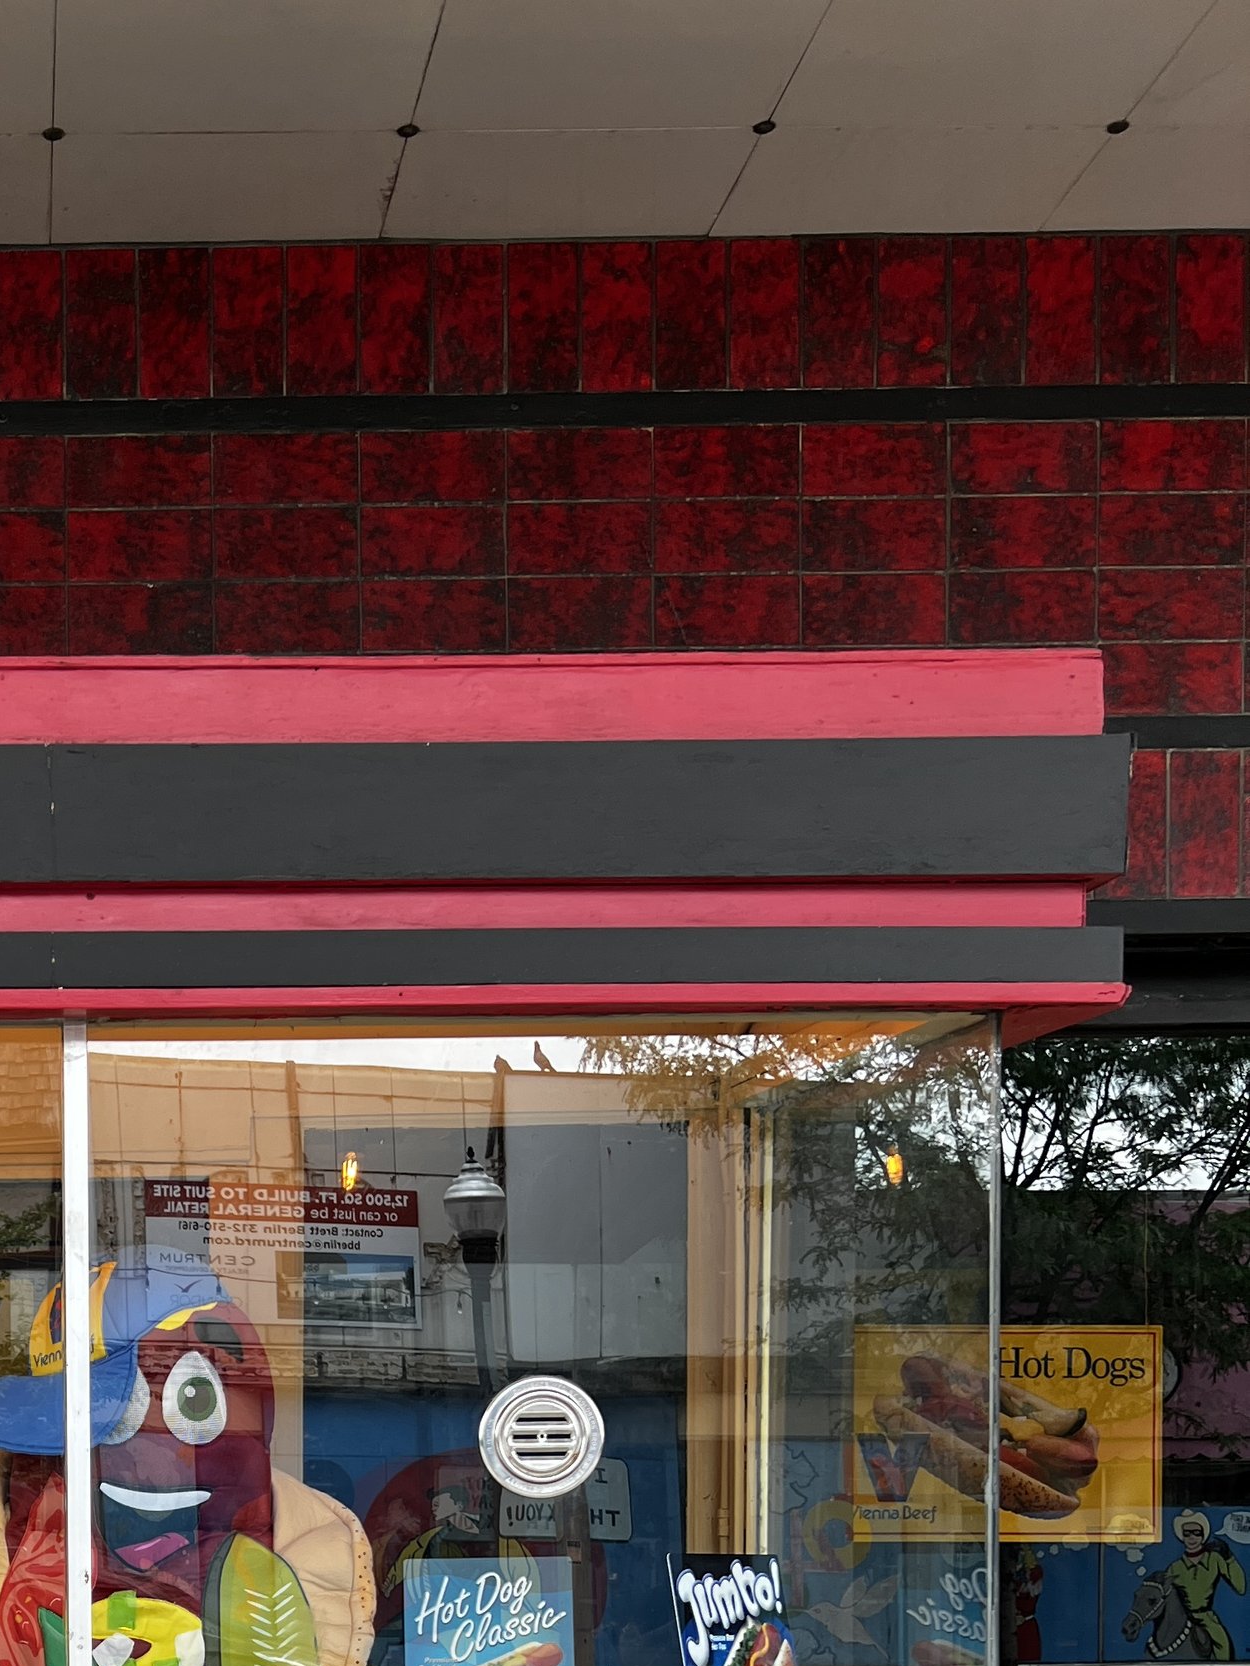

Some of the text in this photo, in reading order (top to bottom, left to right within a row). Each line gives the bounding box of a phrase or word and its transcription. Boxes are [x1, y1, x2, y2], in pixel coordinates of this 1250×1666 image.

[33, 1350, 63, 1368] Vienn
[999, 1347, 1146, 1387] Hot Dogs
[902, 1505, 938, 1524] Beef
[414, 1571, 533, 1643] Hot Dog
[450, 1600, 567, 1662] Classic
